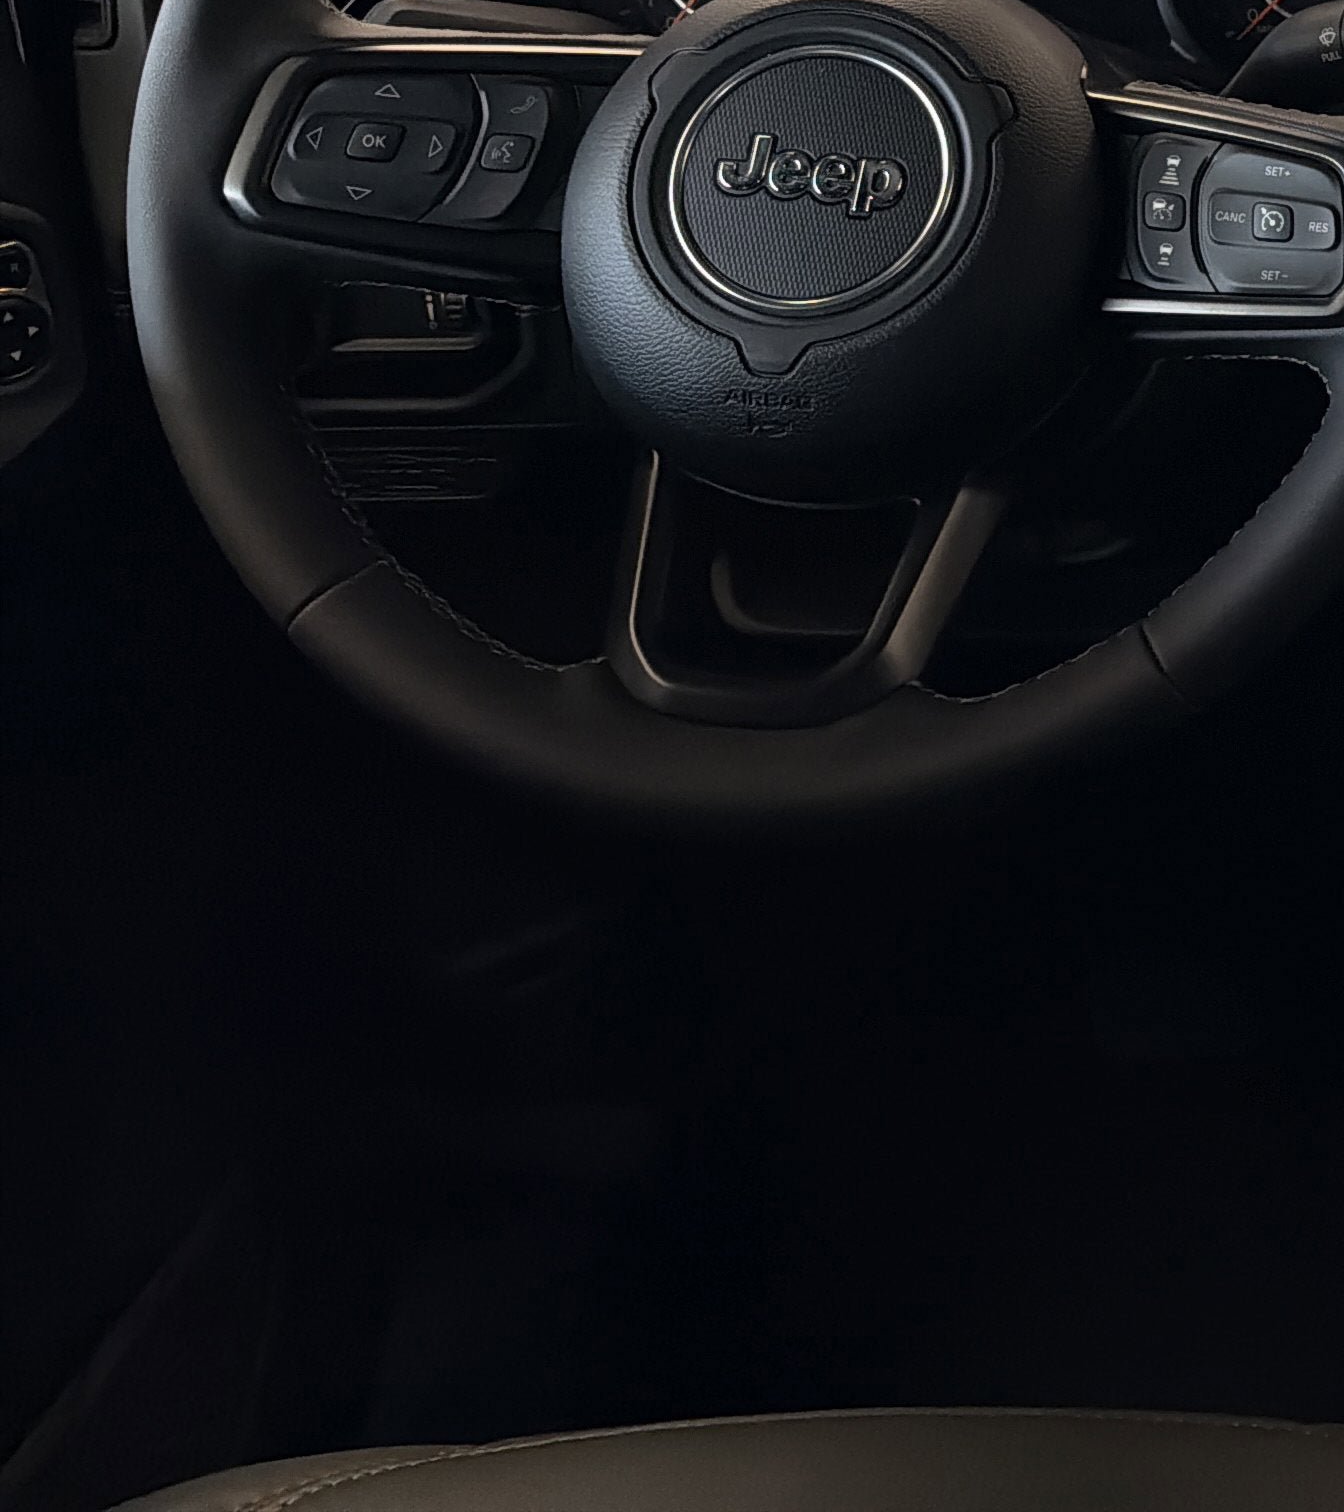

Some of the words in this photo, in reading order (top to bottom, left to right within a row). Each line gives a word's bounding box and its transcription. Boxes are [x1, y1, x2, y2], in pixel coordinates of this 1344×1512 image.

[1321, 51, 1343, 63] PULL
[362, 134, 387, 149] OK
[715, 133, 907, 216] Jeep
[1264, 165, 1291, 177] SET+
[1215, 210, 1246, 224] CANC
[1308, 221, 1329, 233] RES
